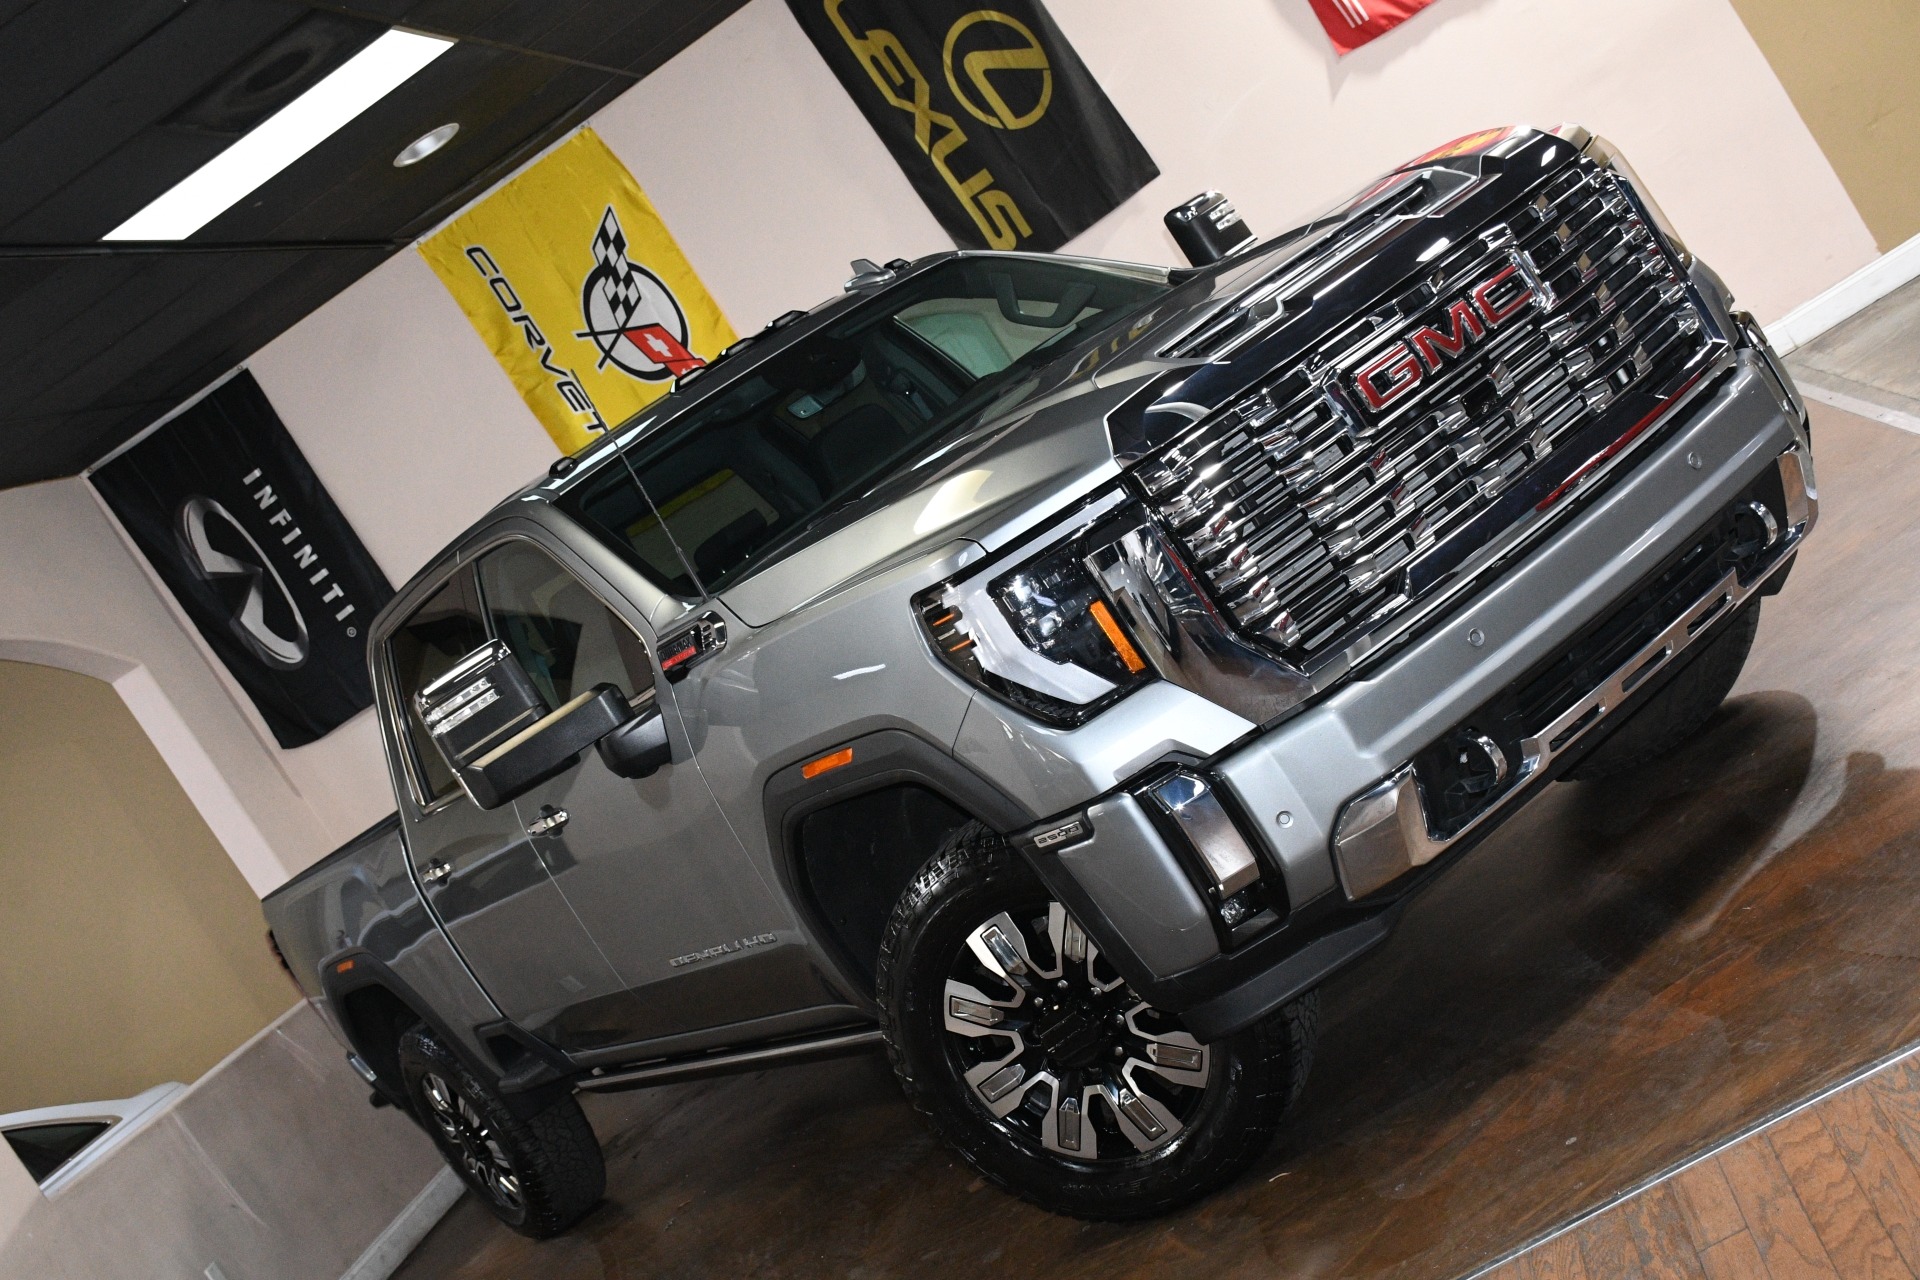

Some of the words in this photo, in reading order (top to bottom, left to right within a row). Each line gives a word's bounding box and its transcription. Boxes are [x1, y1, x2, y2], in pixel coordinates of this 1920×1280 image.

[823, 0, 1033, 250] LEXUS
[1356, 262, 1535, 412] GMC
[242, 467, 356, 622] INFINITI
[1037, 823, 1079, 844] 2500
